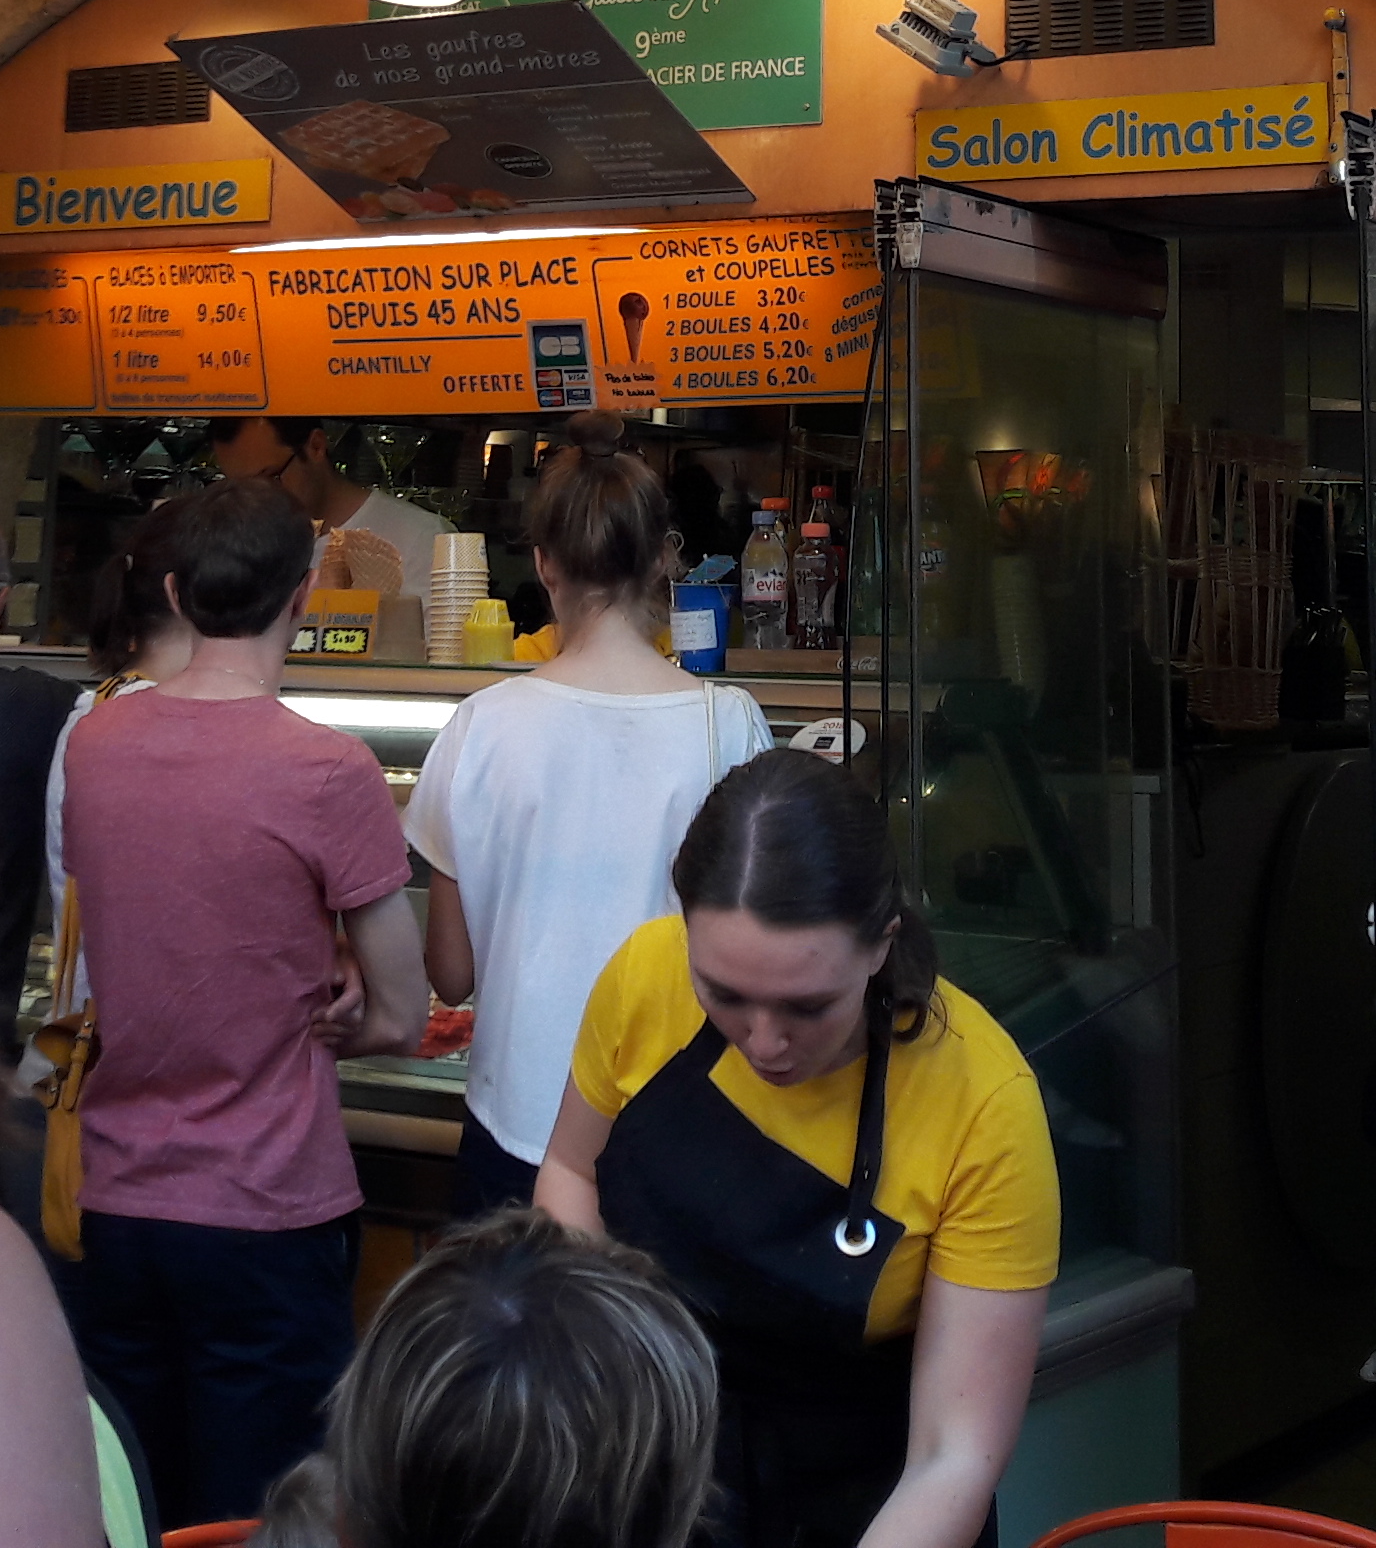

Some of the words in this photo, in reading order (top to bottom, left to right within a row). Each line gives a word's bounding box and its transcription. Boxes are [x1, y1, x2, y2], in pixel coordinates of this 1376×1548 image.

[363, 42, 411, 62] Les
[426, 30, 526, 60] gaufres
[634, 26, 687, 59] 9ème
[335, 68, 361, 88] de
[374, 67, 421, 85] nos
[436, 50, 601, 84] grand-mères
[701, 60, 726, 82] DE
[730, 56, 806, 81] FRANCE
[927, 118, 1058, 169] Salon
[1082, 95, 1316, 159] Climatisé
[14, 175, 239, 226] Bienvenue
[639, 237, 738, 260] CORNETS
[109, 266, 155, 287] GLACES
[170, 263, 236, 286] EMPORTER
[269, 264, 432, 296] FABRICATION
[441, 263, 492, 290] SUR
[500, 257, 579, 287] PLACE
[686, 265, 705, 282] et
[714, 256, 835, 281] COUPELLES
[327, 301, 419, 329] DEPUIS
[427, 298, 457, 325] 45
[466, 297, 521, 324] ANS
[663, 294, 670, 310] 1
[676, 291, 736, 309] BOULE
[109, 304, 132, 324] 1/2
[137, 303, 170, 323] litre
[665, 321, 675, 337] 2
[680, 317, 751, 336] BOULES
[670, 348, 679, 363] 3
[685, 344, 755, 363] BOULES
[837, 333, 869, 359] MINI
[113, 349, 120, 368] 1
[127, 349, 159, 368] litre
[198, 349, 251, 370] 14,00€
[328, 355, 432, 376] CHANTILLY
[443, 373, 525, 394] OFFERTE
[673, 374, 682, 389] 4
[687, 371, 759, 389] BOULES
